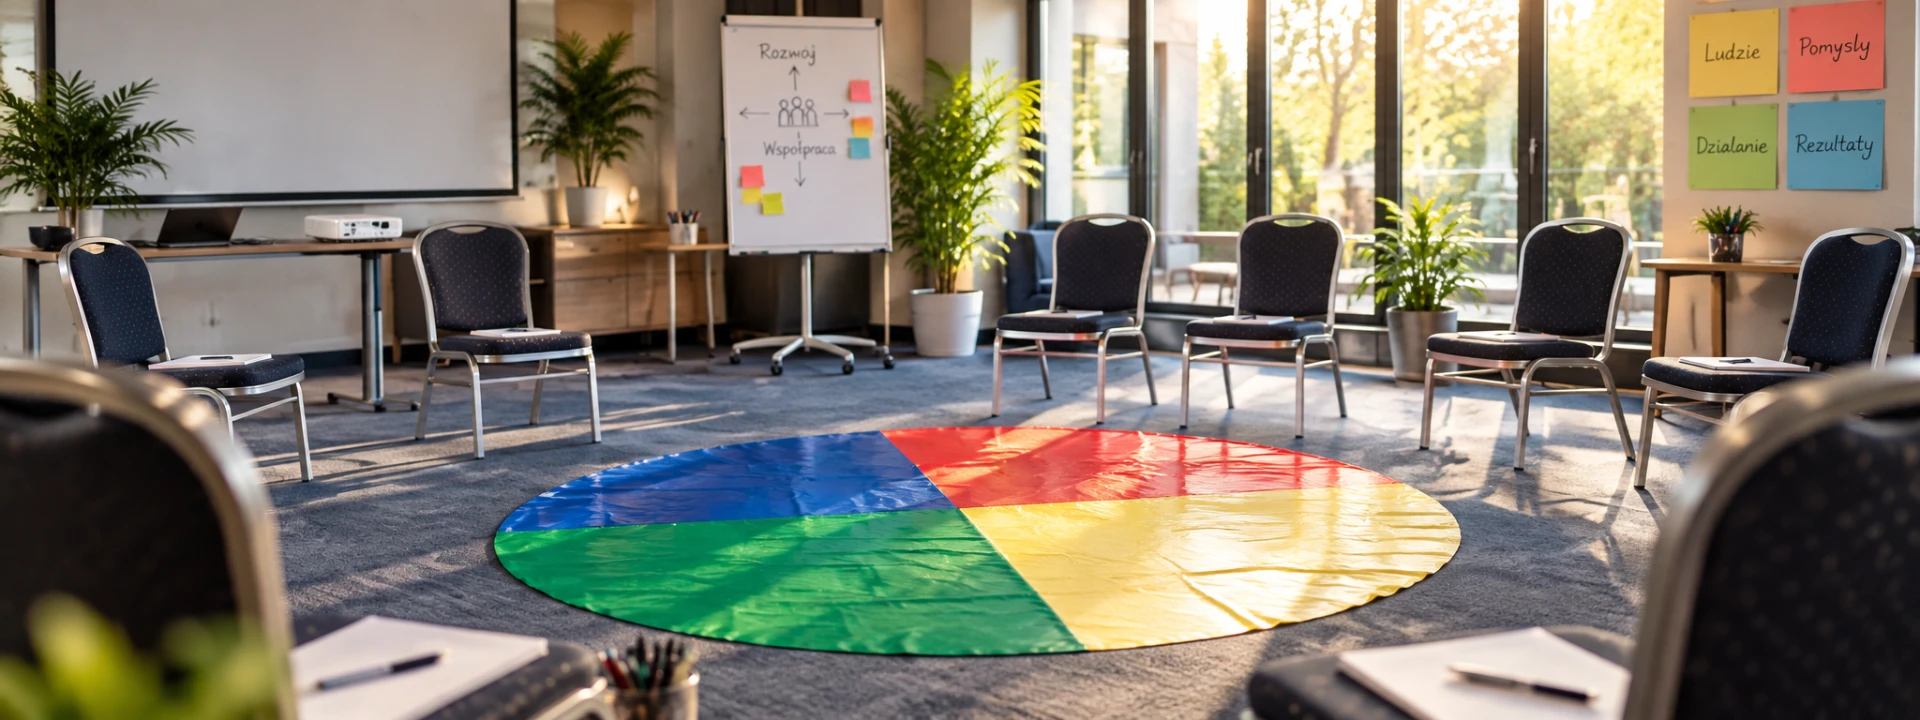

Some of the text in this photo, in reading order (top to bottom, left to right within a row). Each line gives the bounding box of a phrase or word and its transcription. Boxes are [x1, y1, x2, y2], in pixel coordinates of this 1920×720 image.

[1705, 42, 1761, 62] Ludzie
[1799, 33, 1871, 62] Pomysly
[1696, 135, 1769, 155] Dzialanie
[1795, 133, 1874, 160] Rezultaty
